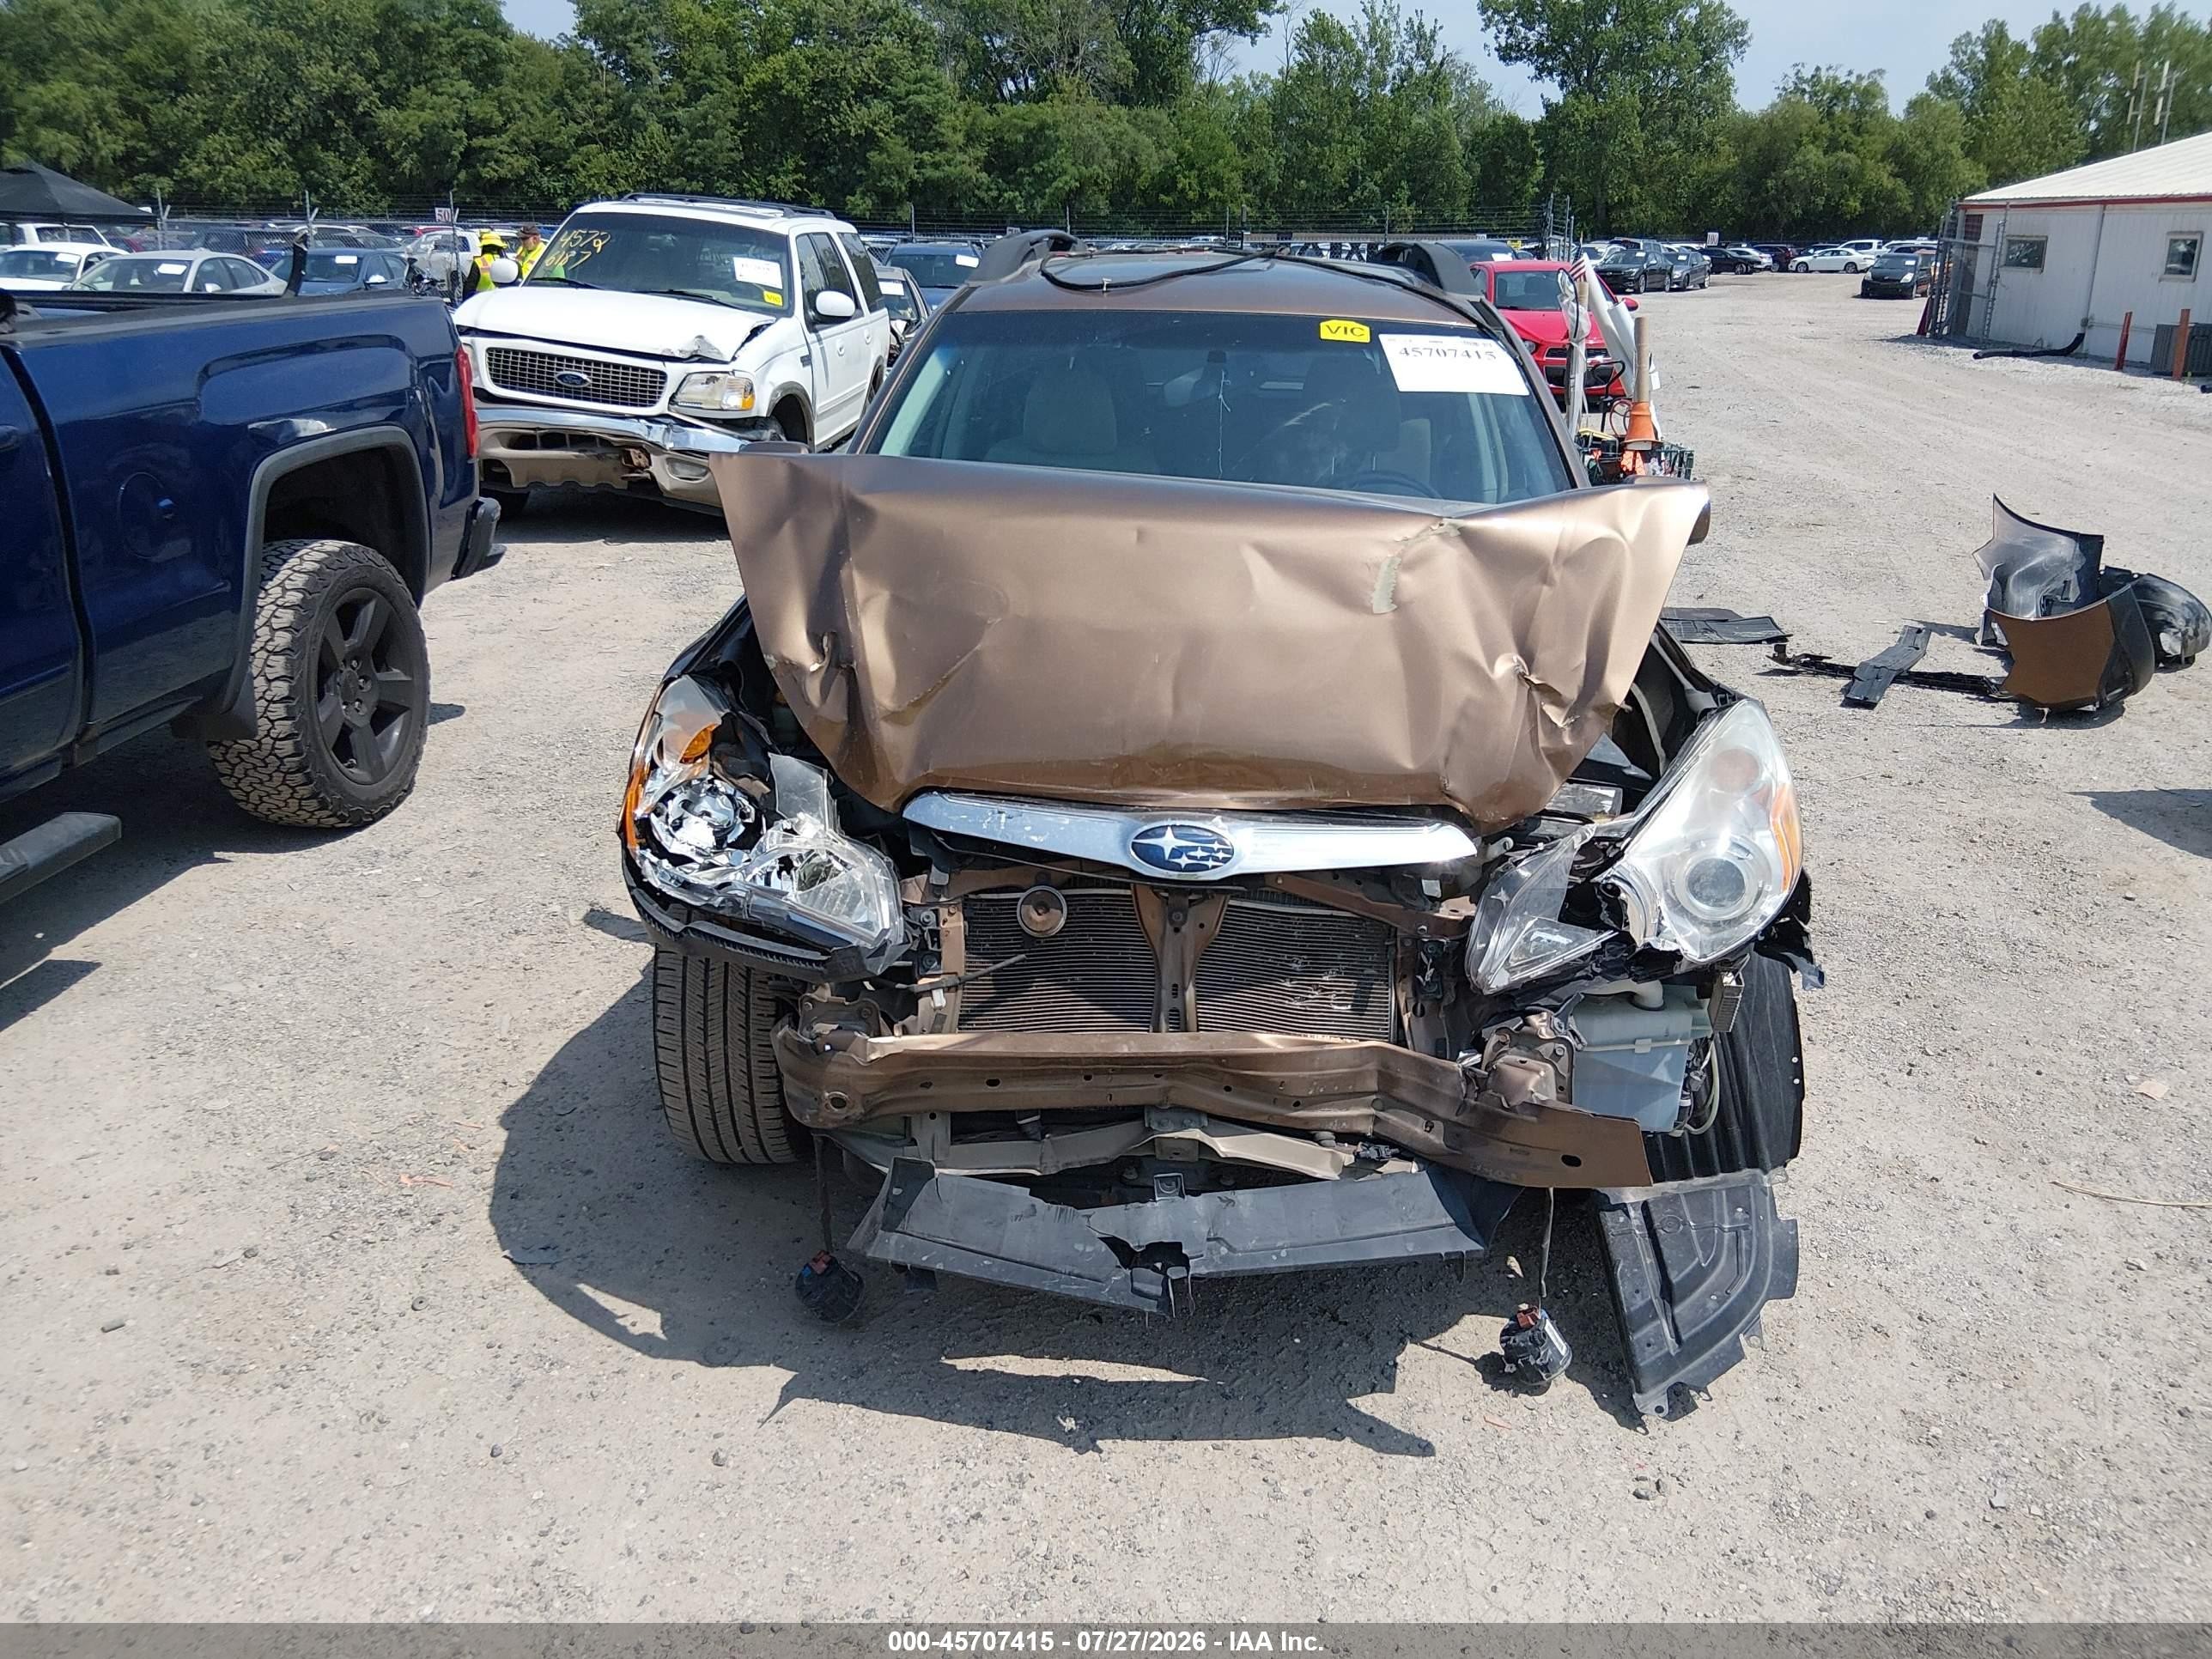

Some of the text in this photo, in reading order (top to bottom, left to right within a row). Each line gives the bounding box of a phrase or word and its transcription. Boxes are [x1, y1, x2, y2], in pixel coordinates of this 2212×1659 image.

[437, 209, 450, 222] 50
[1325, 324, 1365, 337] VIC
[1399, 347, 1497, 360] 45707415
